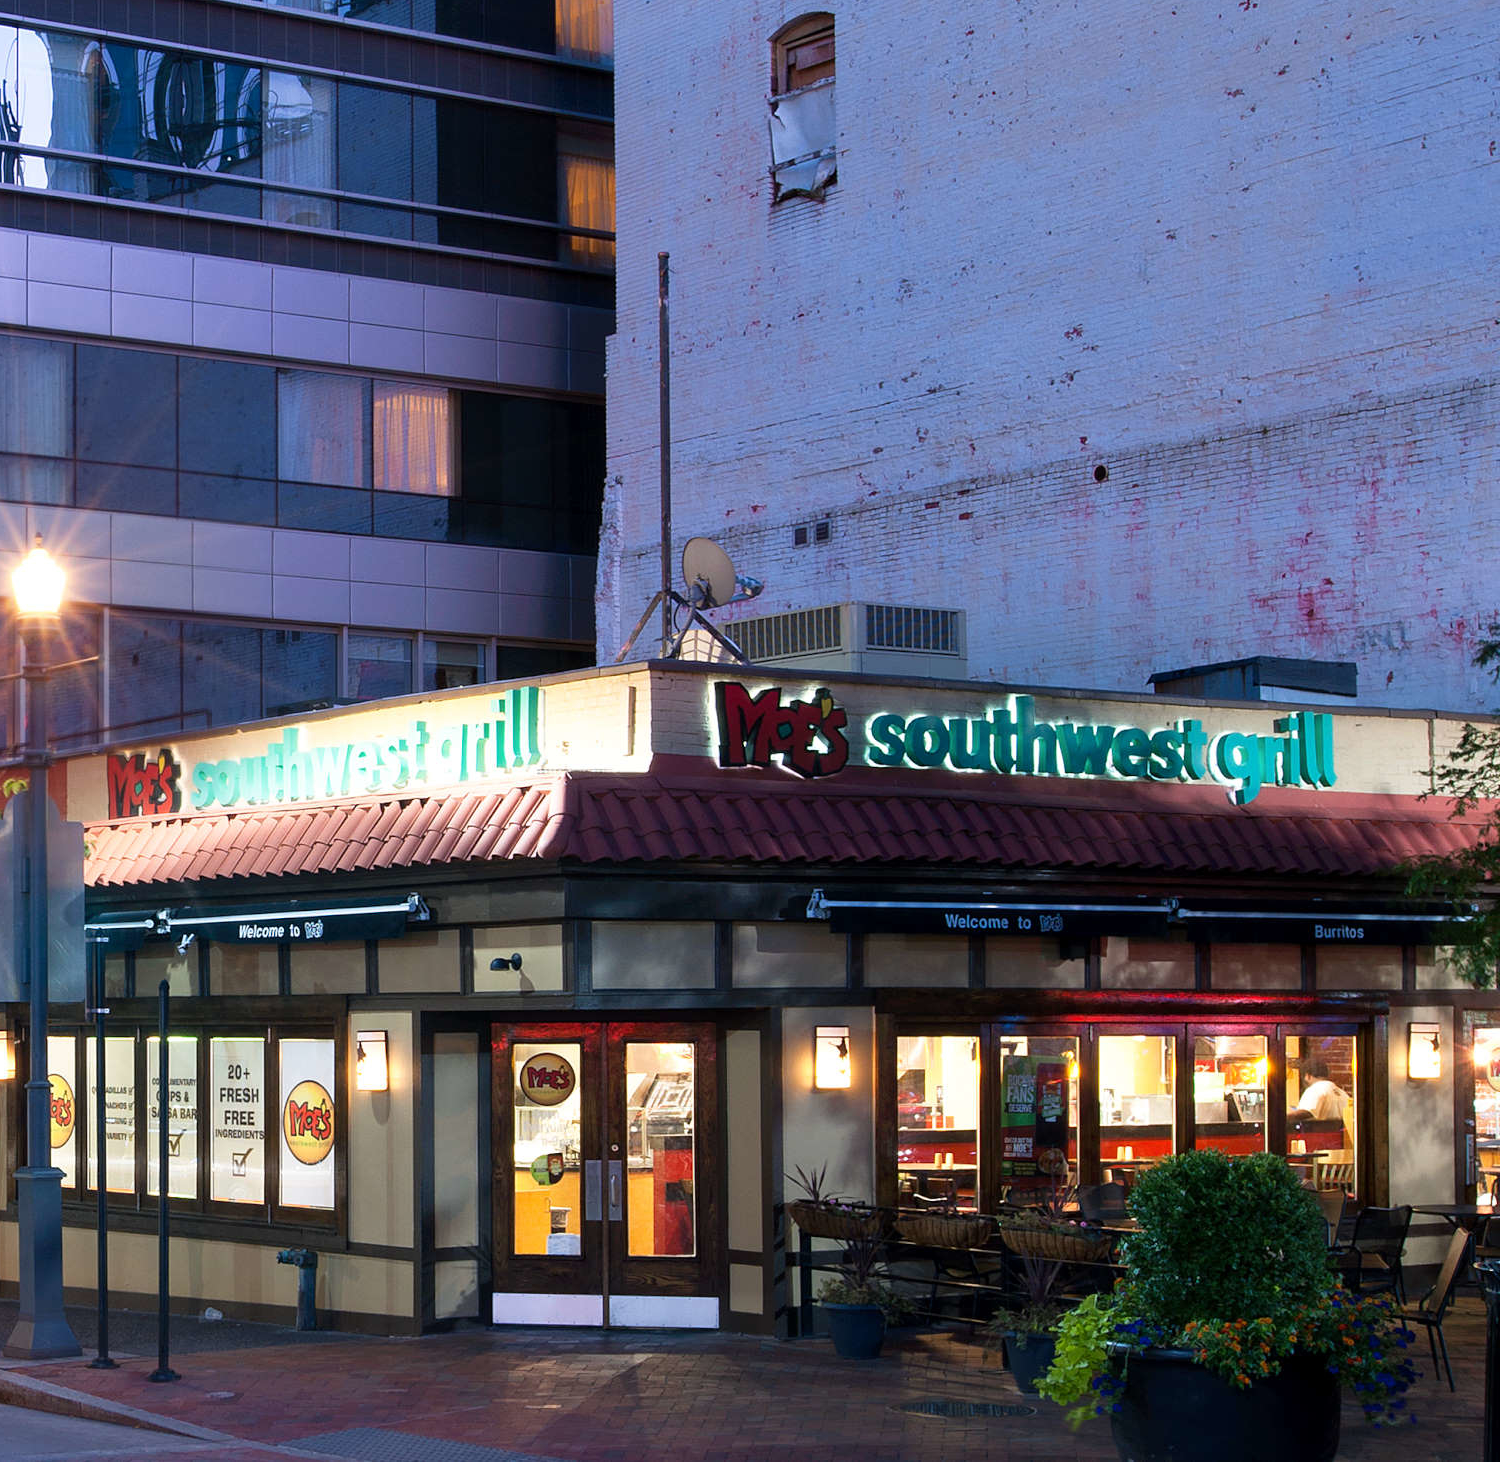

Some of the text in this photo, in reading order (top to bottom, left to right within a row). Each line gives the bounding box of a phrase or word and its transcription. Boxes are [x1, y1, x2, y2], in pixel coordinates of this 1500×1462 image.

[190, 721, 430, 809] southwest
[436, 686, 545, 782] grill
[867, 693, 1207, 781] southwest
[1214, 710, 1338, 805] grill
[945, 914, 1009, 929] Welcome
[1018, 916, 1032, 930] to
[239, 924, 285, 938] Welcome
[290, 924, 301, 937] to
[1315, 924, 1365, 939] Burritos
[228, 1064, 251, 1080] 20+
[156, 1090, 190, 1103] CPS &
[220, 1087, 259, 1103] FRESH
[1006, 1086, 1035, 1103] FANS
[224, 1110, 255, 1126] FREE
[215, 1129, 265, 1140] INGREDIENTS
